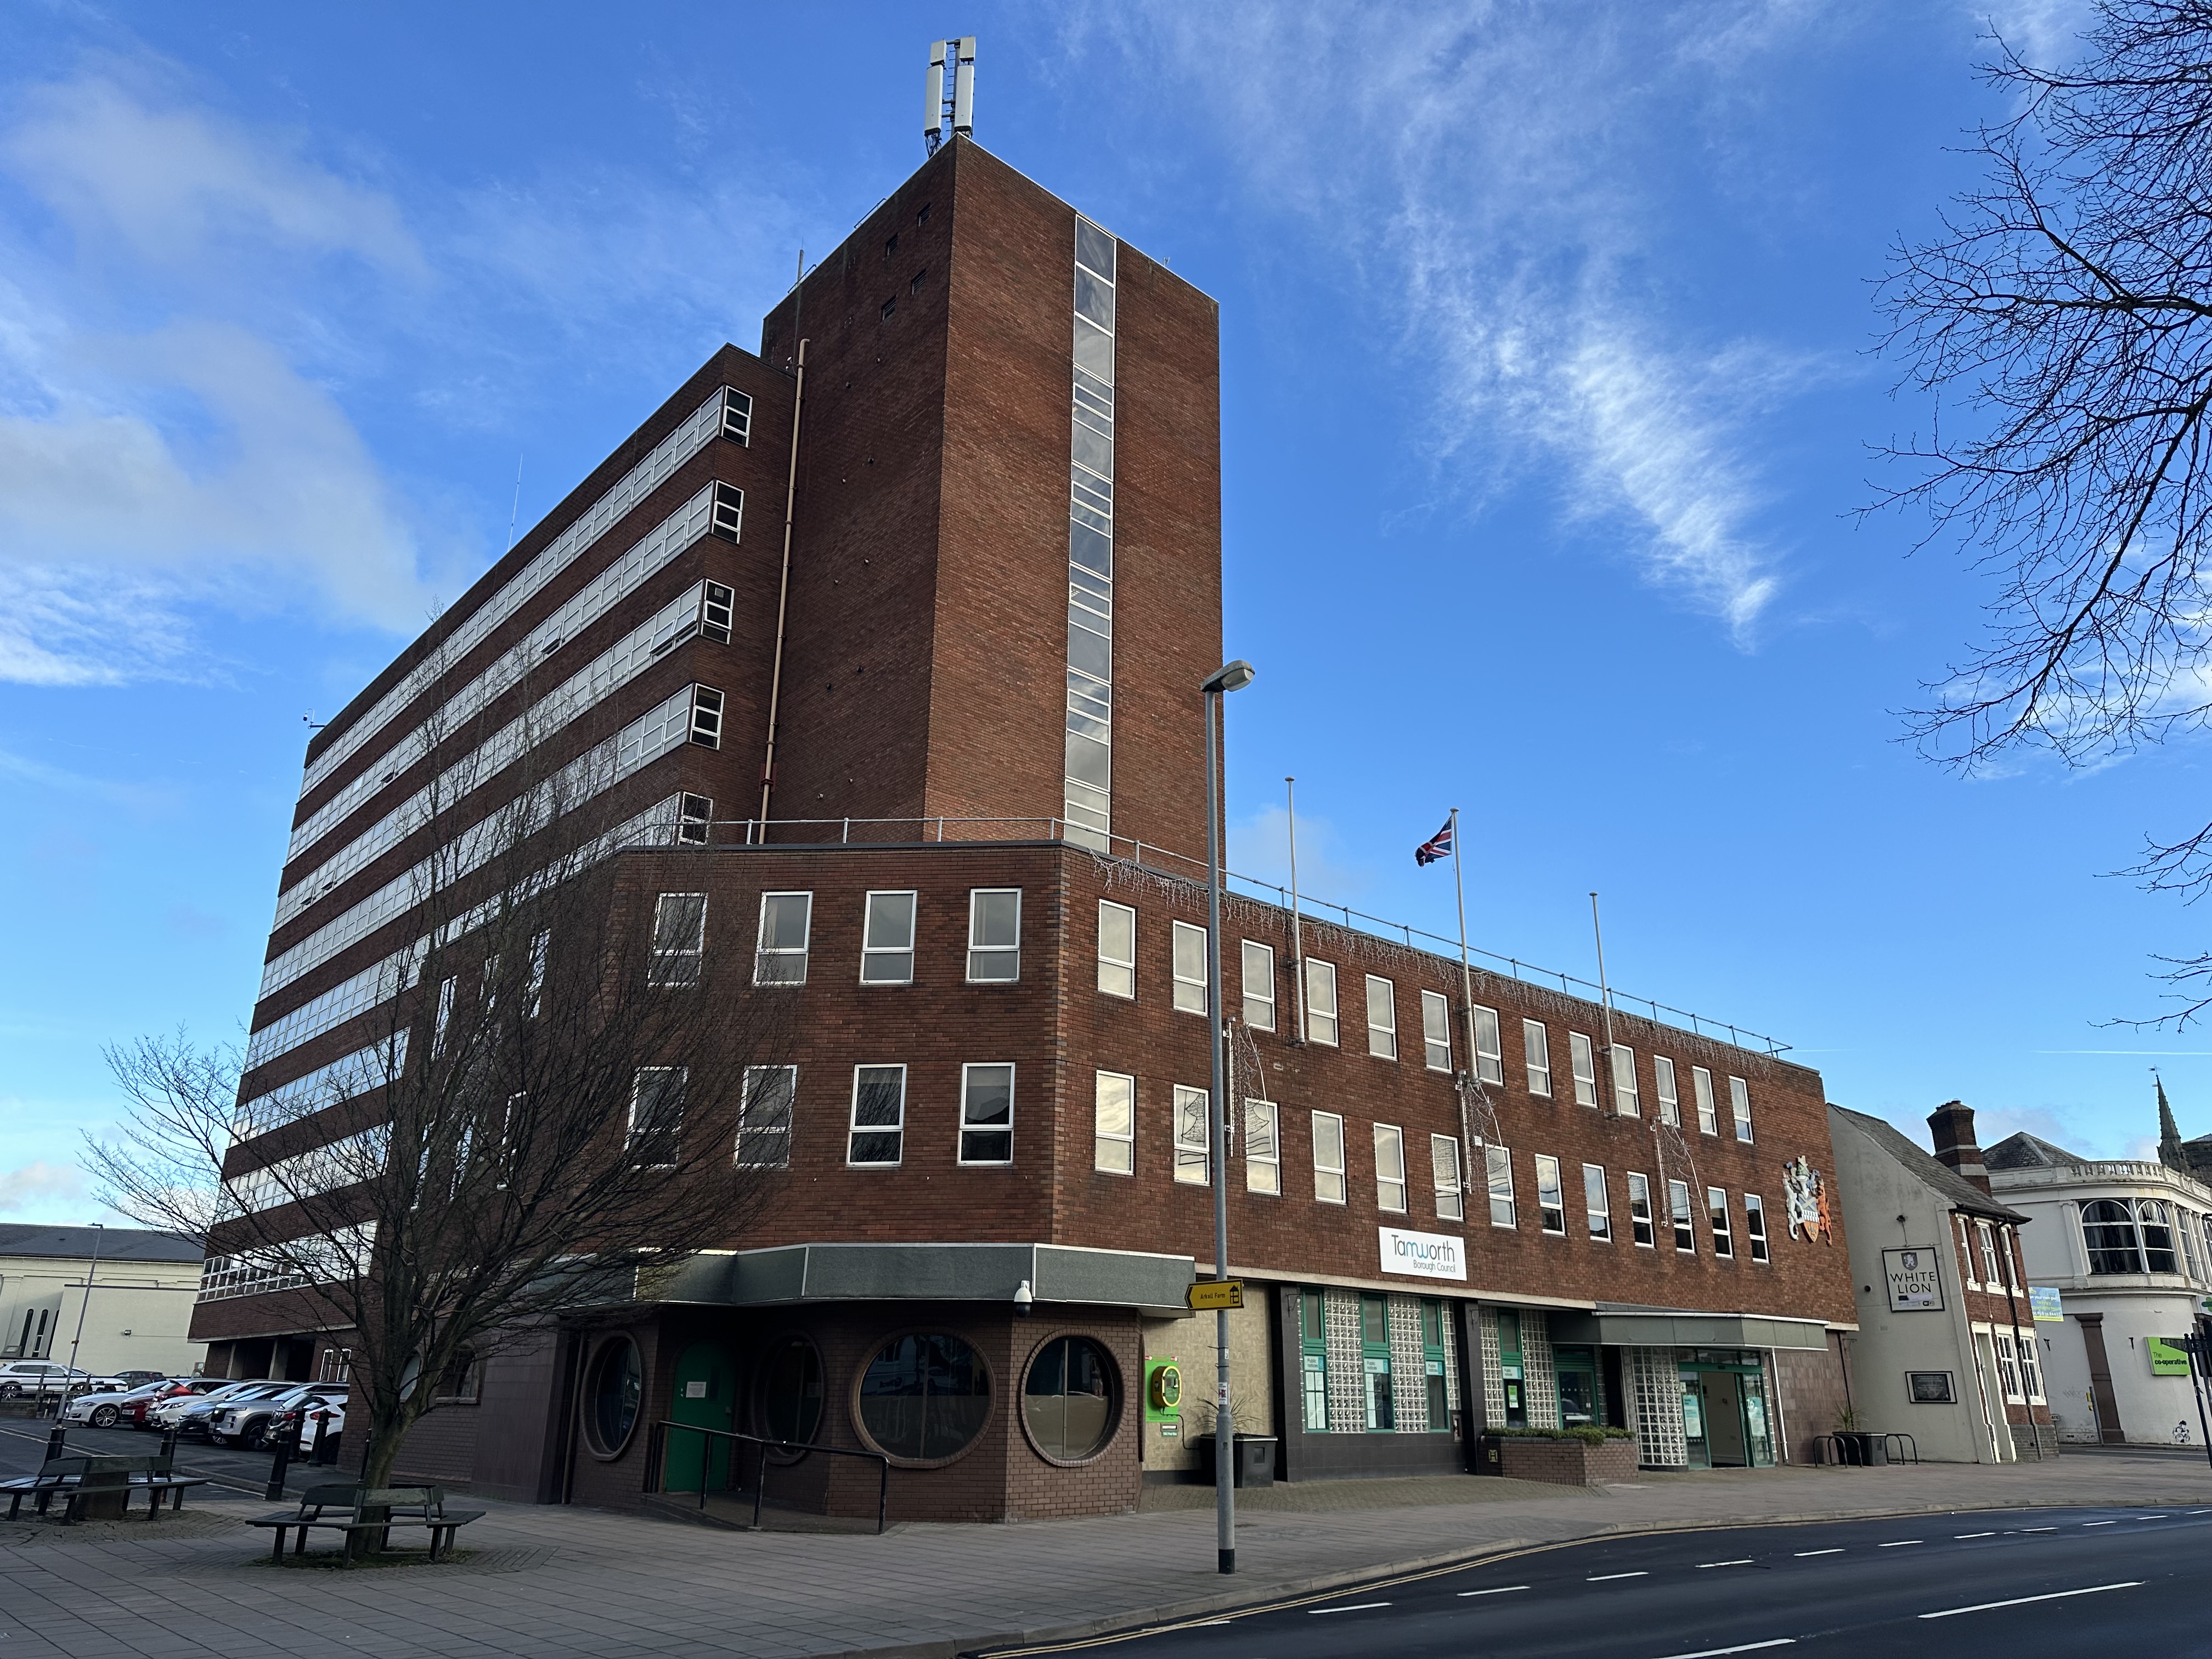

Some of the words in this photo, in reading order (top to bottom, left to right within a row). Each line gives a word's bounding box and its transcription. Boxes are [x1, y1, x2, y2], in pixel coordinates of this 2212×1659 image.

[1391, 1234, 1455, 1262] Tamworth
[1413, 1259, 1436, 1272] Borough
[1437, 1262, 1455, 1273] Council
[1890, 1272, 1936, 1283] WHITE
[1898, 1283, 1931, 1294] LION
